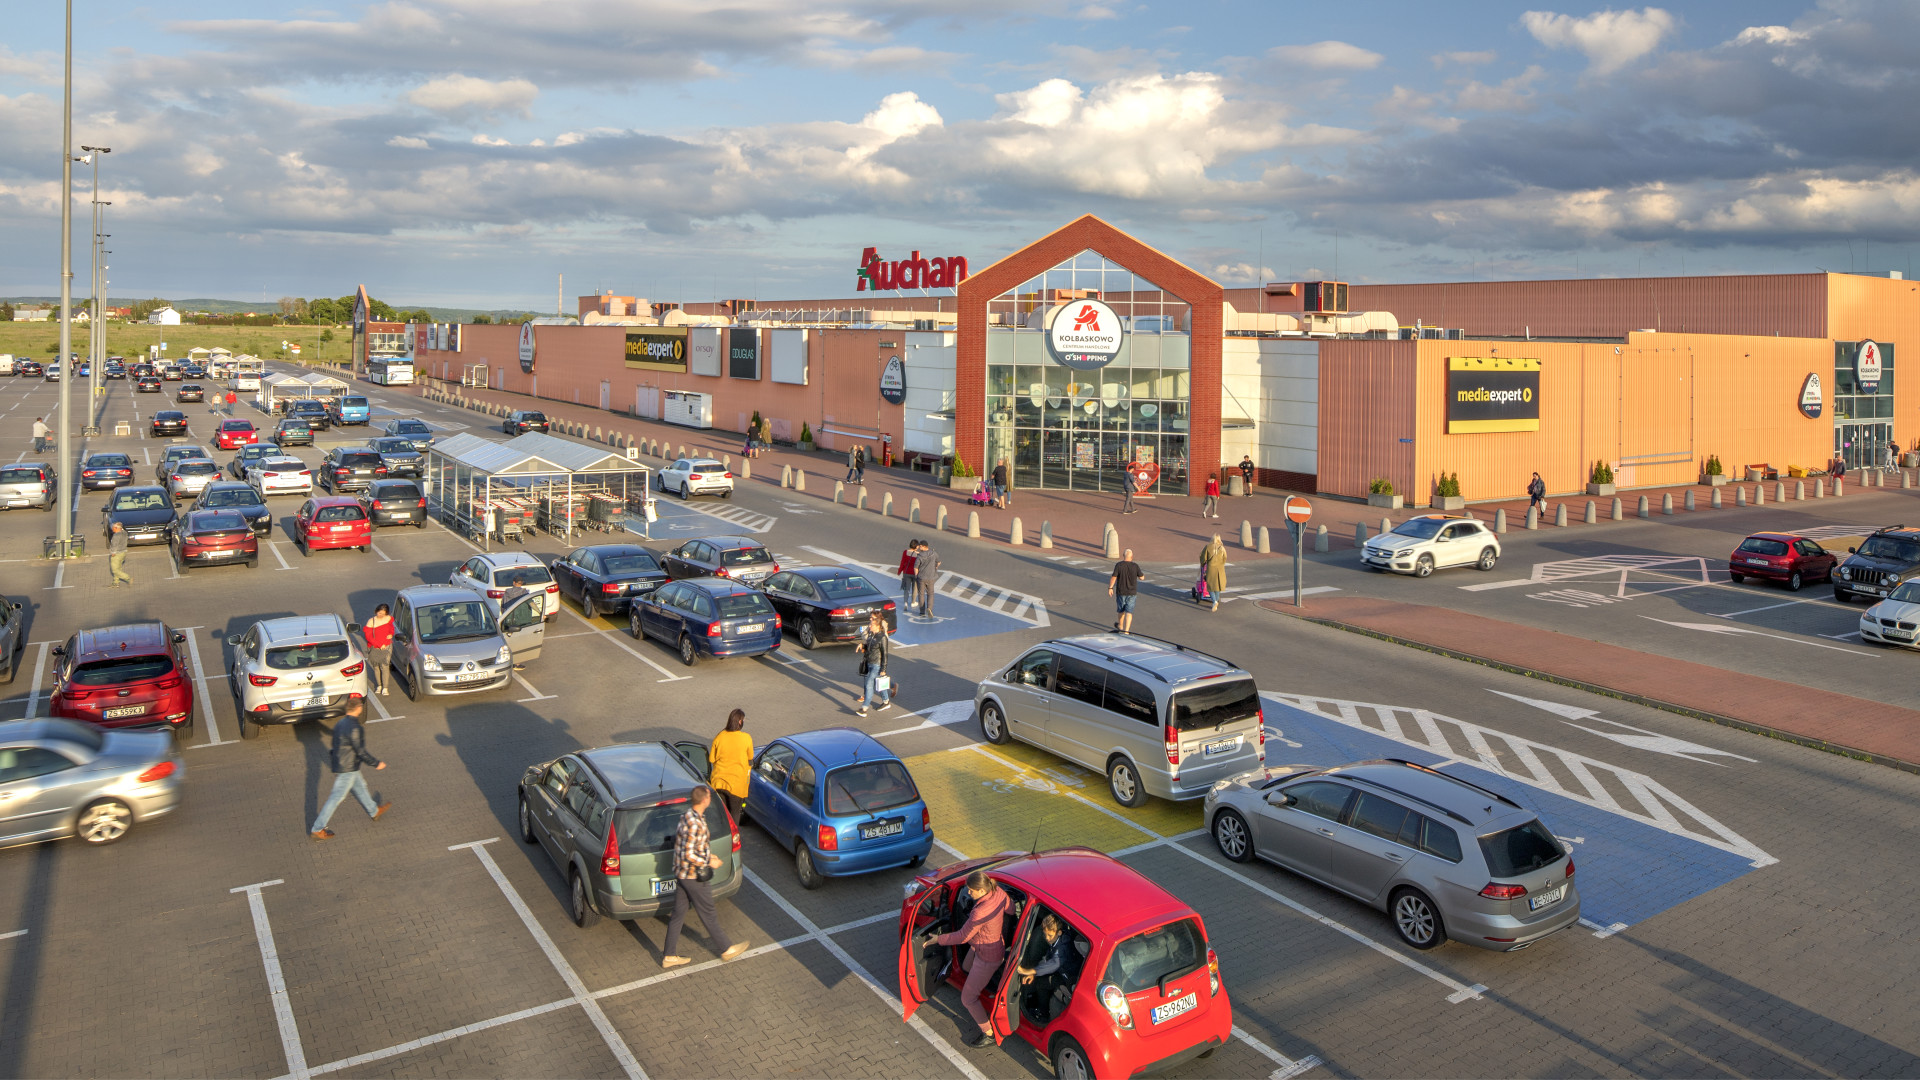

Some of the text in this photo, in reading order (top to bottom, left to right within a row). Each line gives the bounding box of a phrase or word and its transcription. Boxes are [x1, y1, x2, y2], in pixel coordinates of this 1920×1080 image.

[856, 247, 968, 291] Auchan
[732, 348, 754, 359] DOUGLAS
[1457, 386, 1522, 404] mediaexpert
[108, 710, 118, 718] ZS
[866, 828, 876, 837] ZS
[1156, 994, 1195, 1019] ZS 962NU
